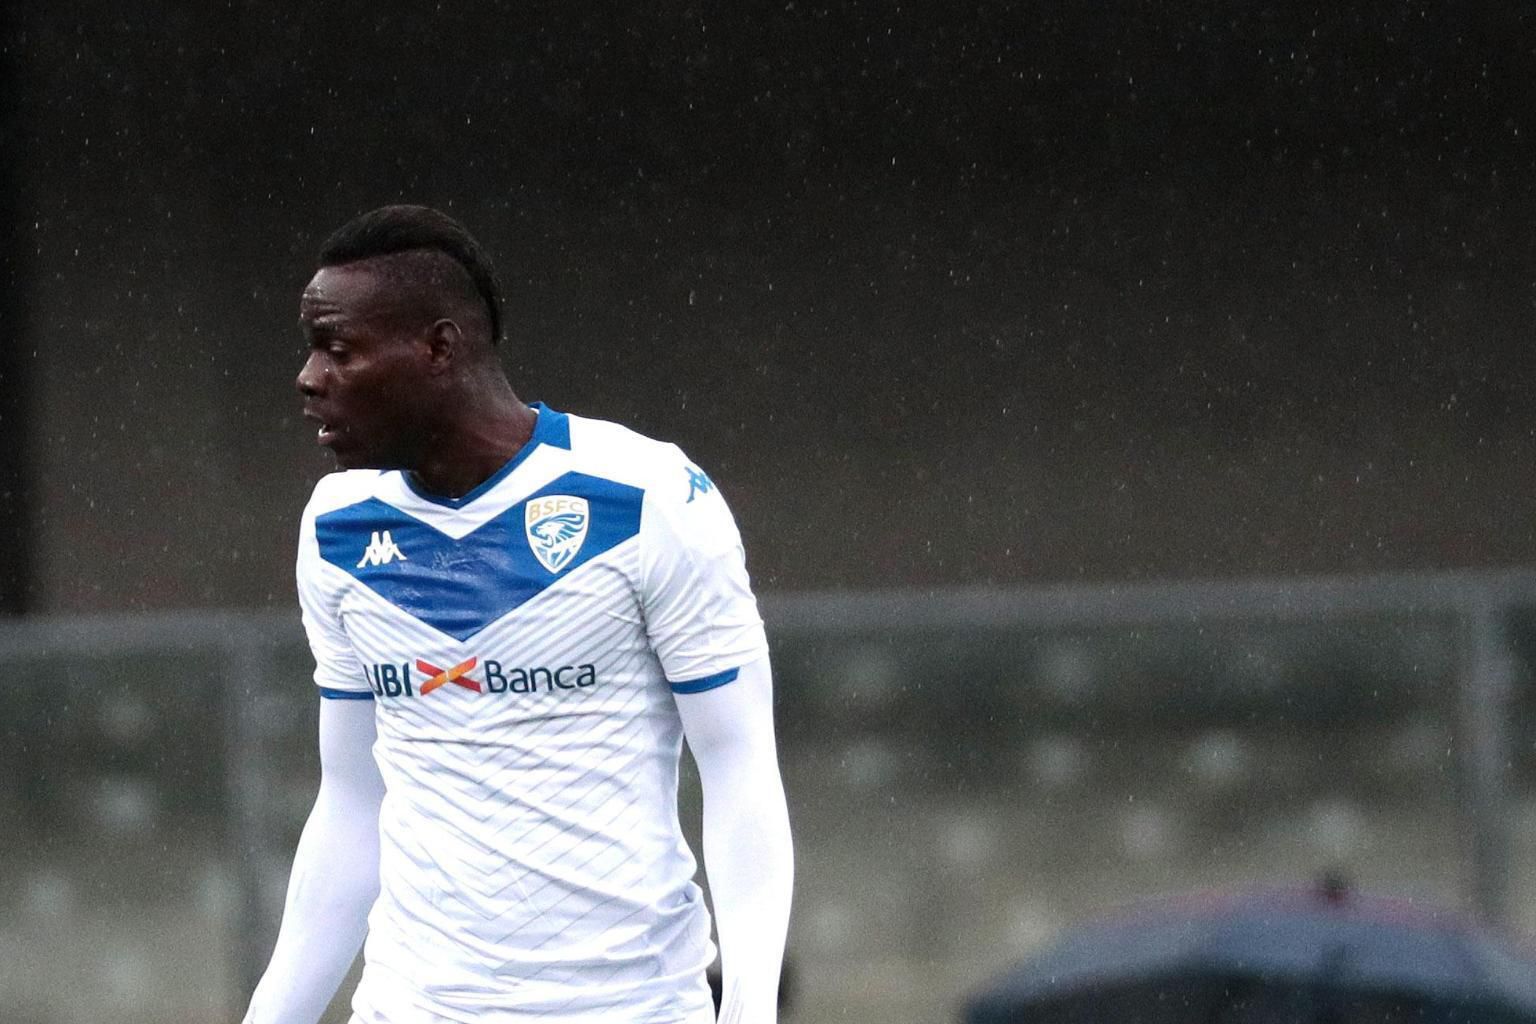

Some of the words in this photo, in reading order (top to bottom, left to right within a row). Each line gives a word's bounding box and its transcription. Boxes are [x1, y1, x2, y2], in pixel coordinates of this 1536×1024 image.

[529, 500, 585, 523] BSFC
[363, 662, 413, 697] UBI
[483, 660, 596, 694] Banca
